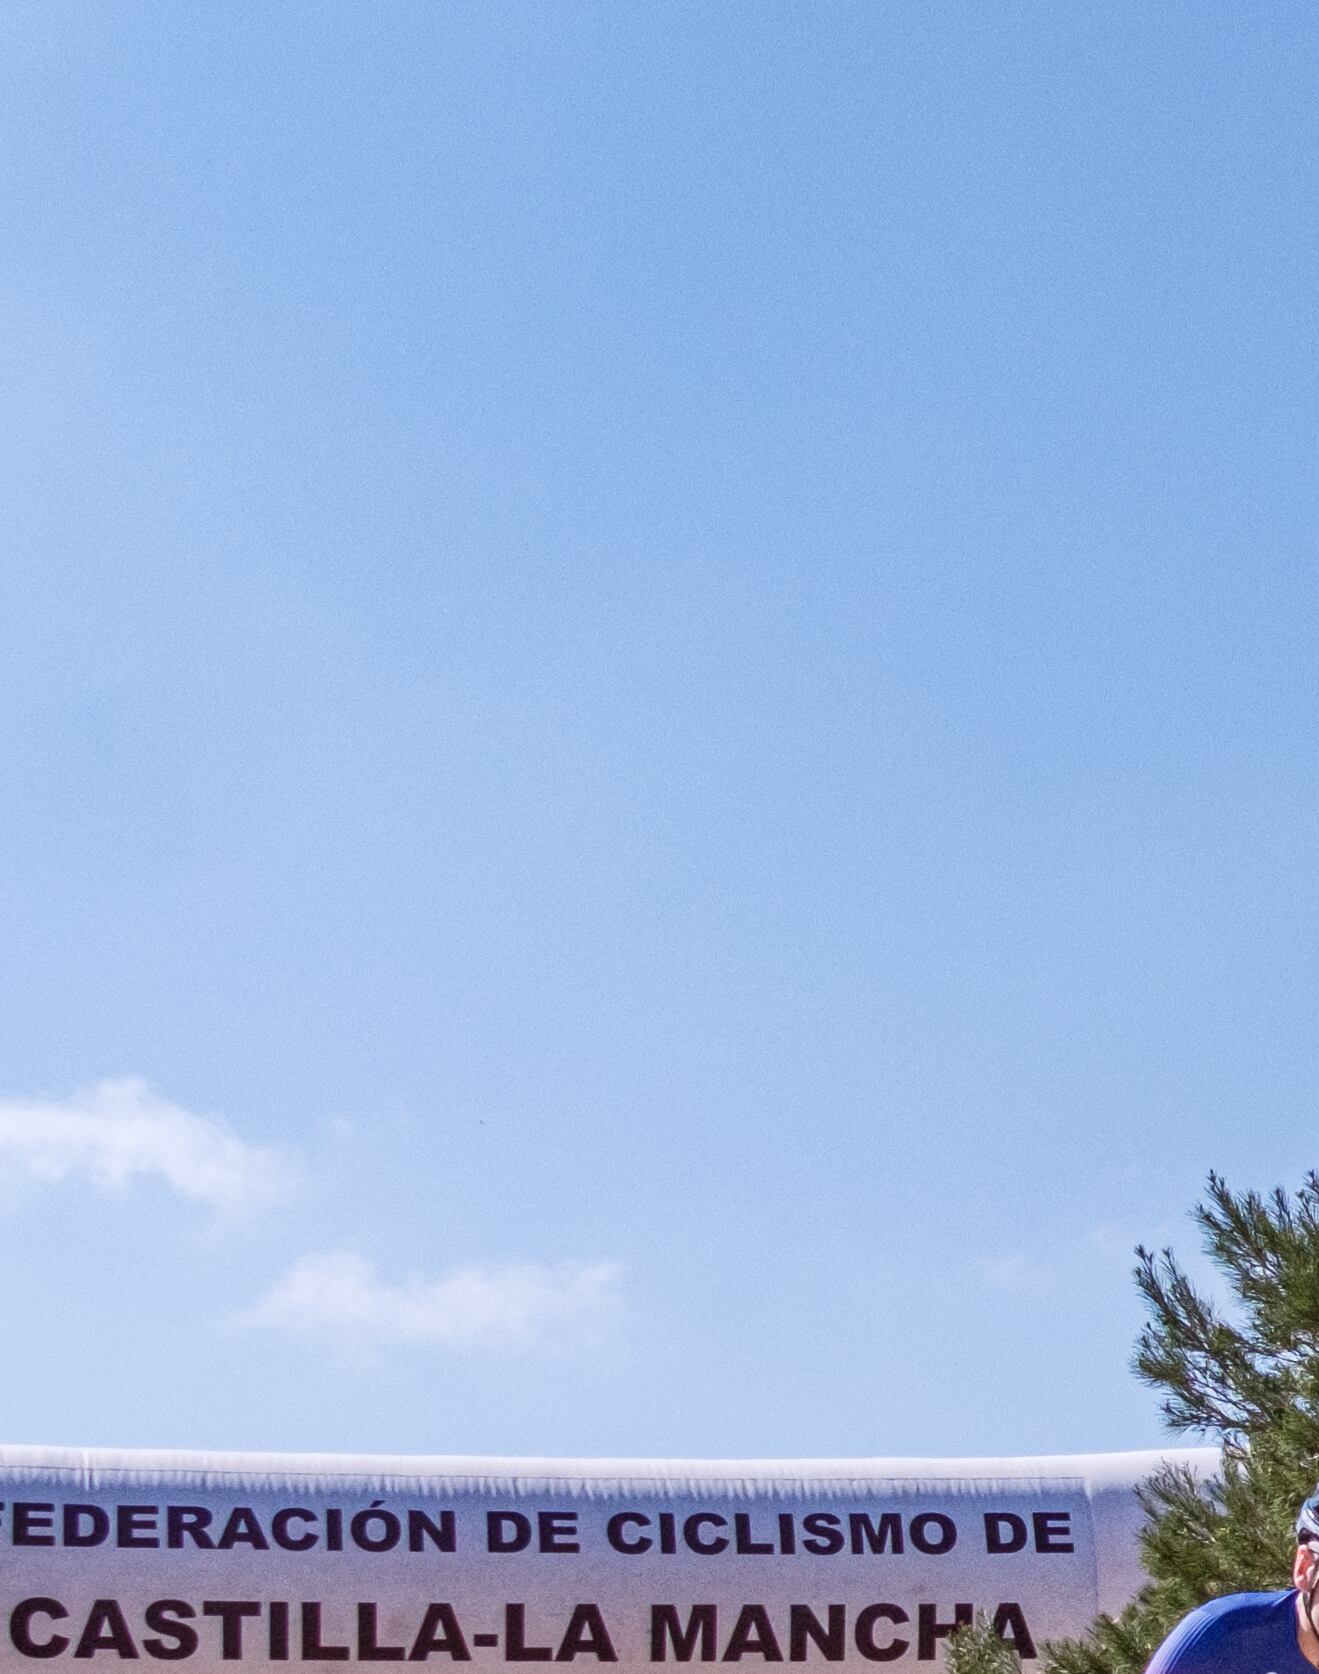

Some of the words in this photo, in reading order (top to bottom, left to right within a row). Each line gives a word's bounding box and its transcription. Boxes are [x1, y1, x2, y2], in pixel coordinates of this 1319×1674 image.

[0, 1500, 457, 1553] EDERACIÓN
[486, 1510, 581, 1554] DE
[606, 1511, 958, 1556] CICLISMO
[983, 1511, 1075, 1554] DE
[10, 1597, 619, 1661] CASTILLA-LA
[650, 1602, 1039, 1662] MANCHA
